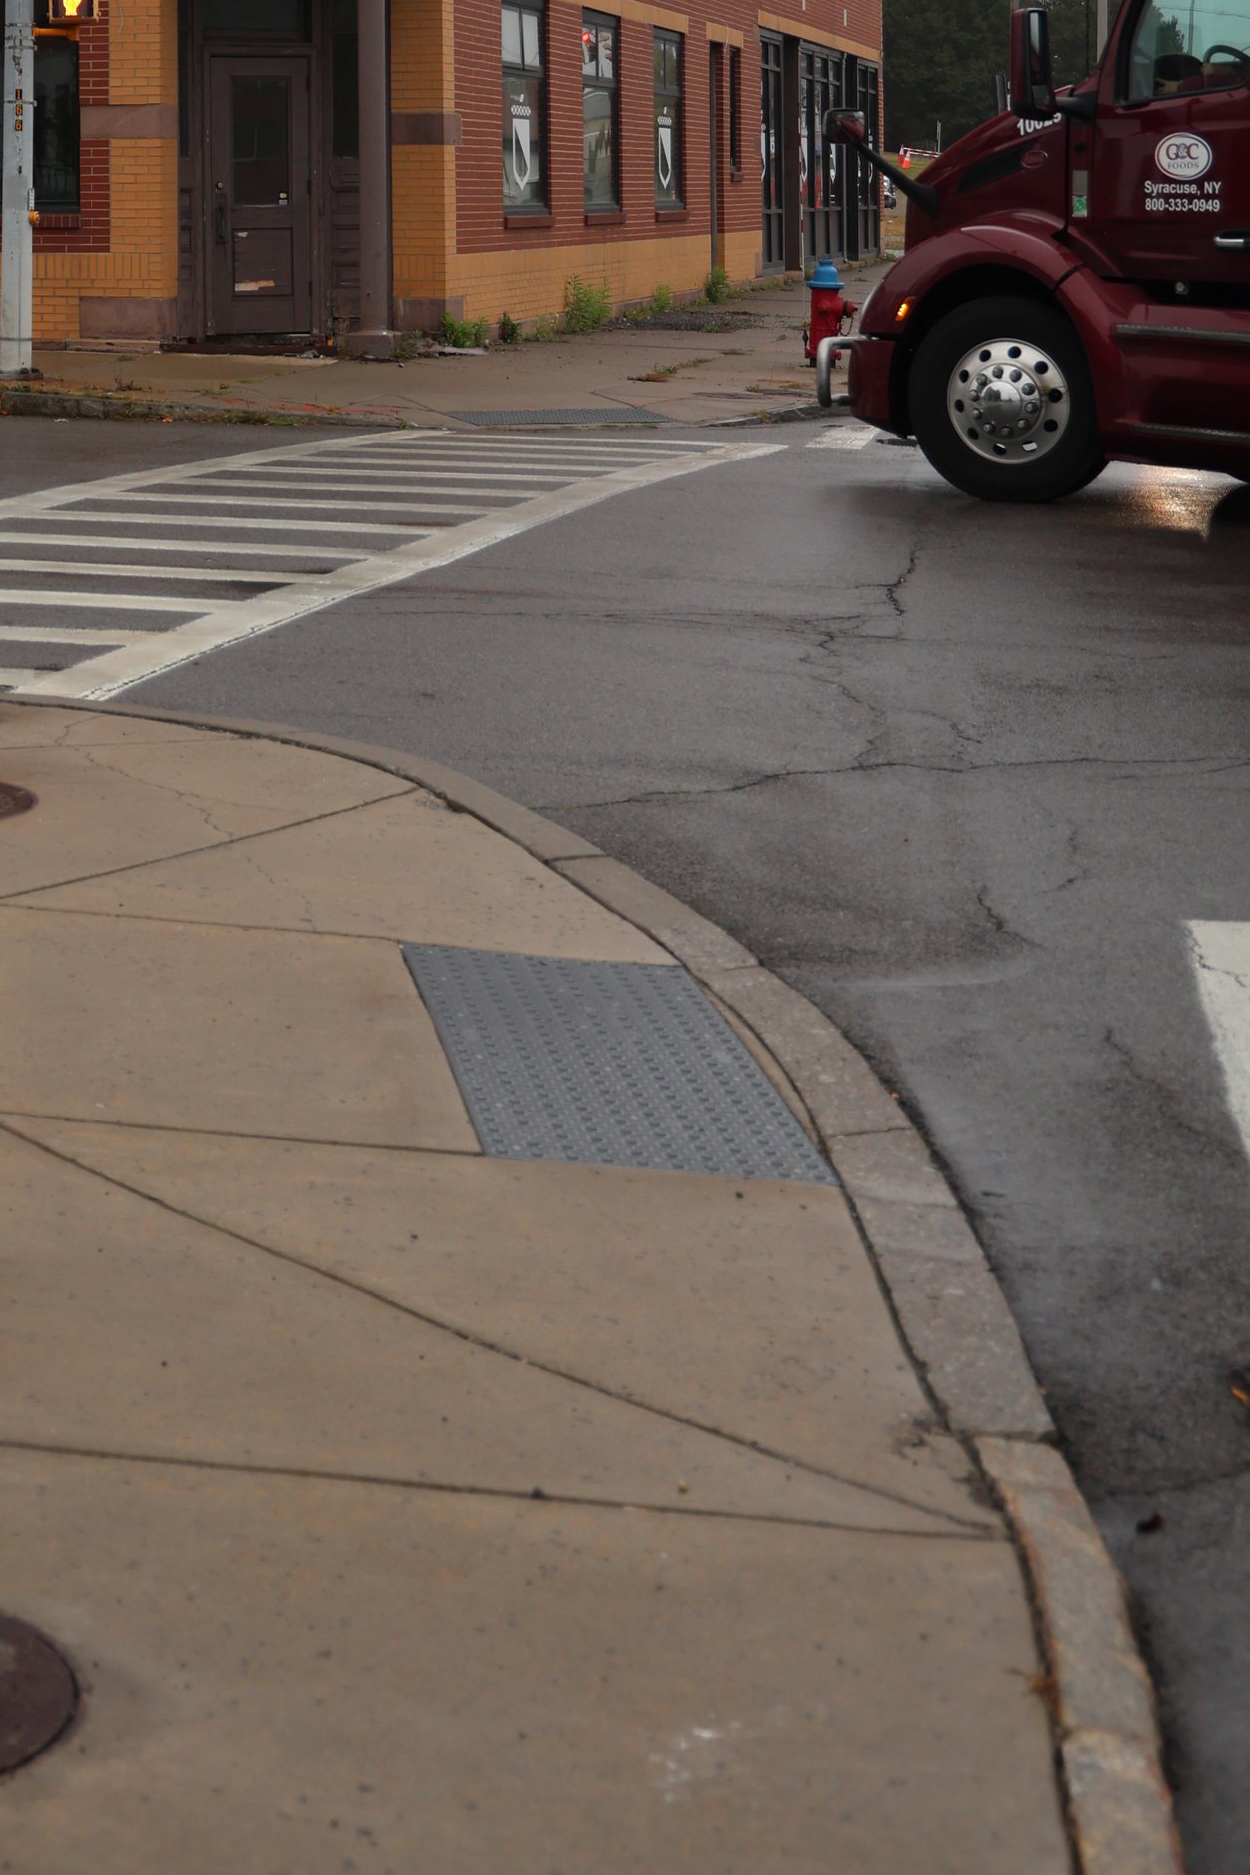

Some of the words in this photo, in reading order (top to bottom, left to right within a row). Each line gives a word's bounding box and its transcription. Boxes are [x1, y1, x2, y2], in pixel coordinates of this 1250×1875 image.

[1165, 142, 1199, 161] G&C
[1166, 161, 1200, 170] FOODS
[1143, 180, 1201, 197] Syracuse,
[1203, 181, 1222, 195] NY
[1144, 198, 1221, 213] 800-333-0949
